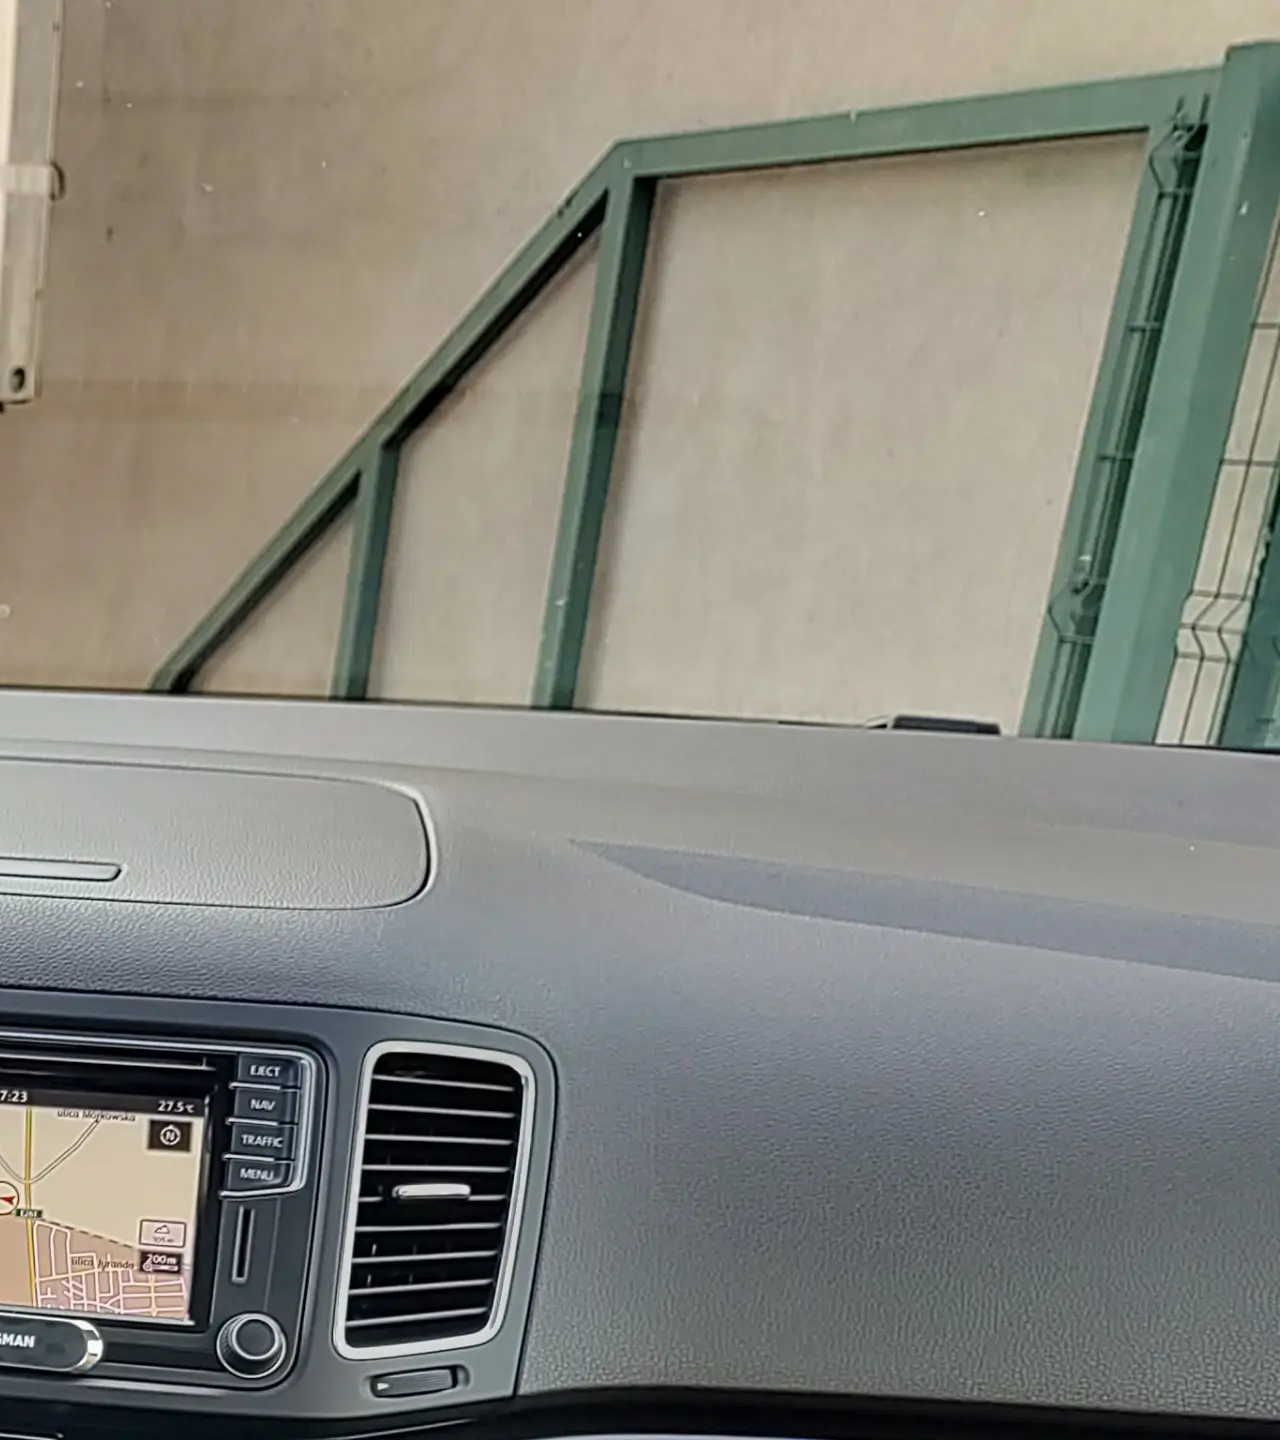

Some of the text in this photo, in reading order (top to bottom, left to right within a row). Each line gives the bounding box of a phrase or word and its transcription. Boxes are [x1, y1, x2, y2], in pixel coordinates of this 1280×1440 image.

[250, 1065, 281, 1078] EJECT
[250, 1099, 276, 1111] NAV
[241, 1133, 284, 1148] TRAFFIC
[240, 1168, 274, 1181] MENU
